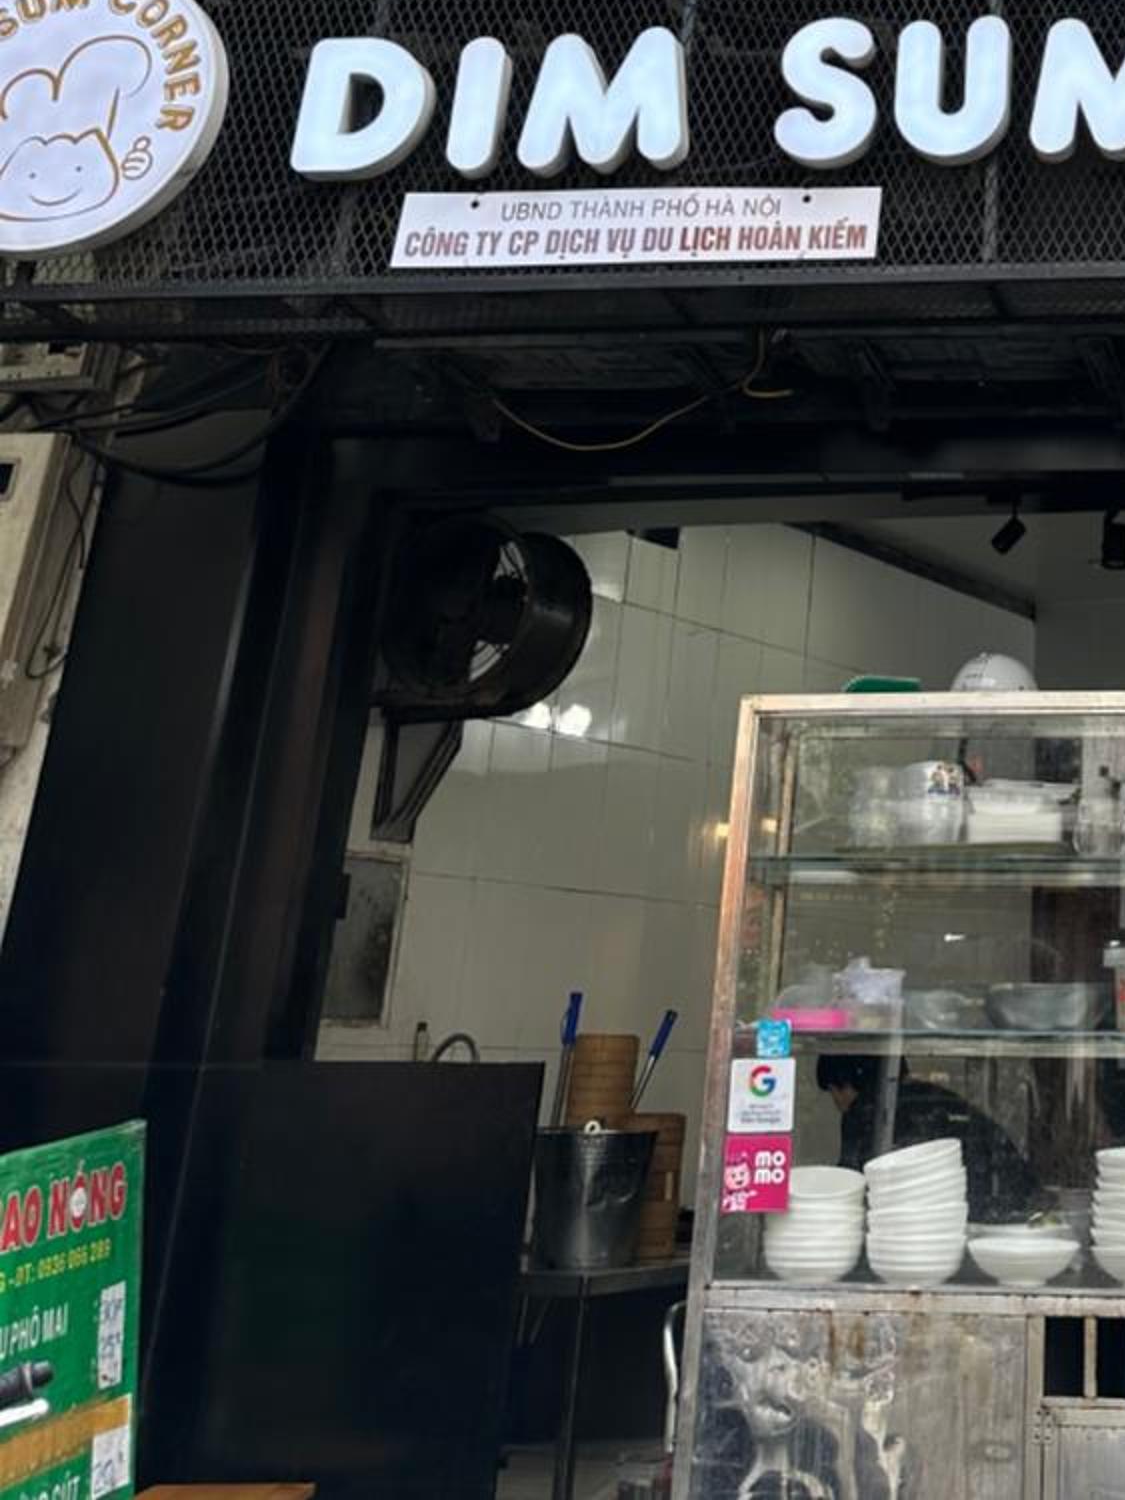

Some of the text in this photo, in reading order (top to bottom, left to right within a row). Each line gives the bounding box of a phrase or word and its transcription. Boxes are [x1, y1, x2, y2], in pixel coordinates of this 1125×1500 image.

[290, 26, 690, 180] DIM
[501, 194, 781, 222] UBND THÀNH PHỐ HÀ NỘI
[404, 217, 868, 260] CÔNG TY CP DỊCH VỤ DU LỊCH HOÀN KIẾM
[750, 1065, 776, 1097] G
